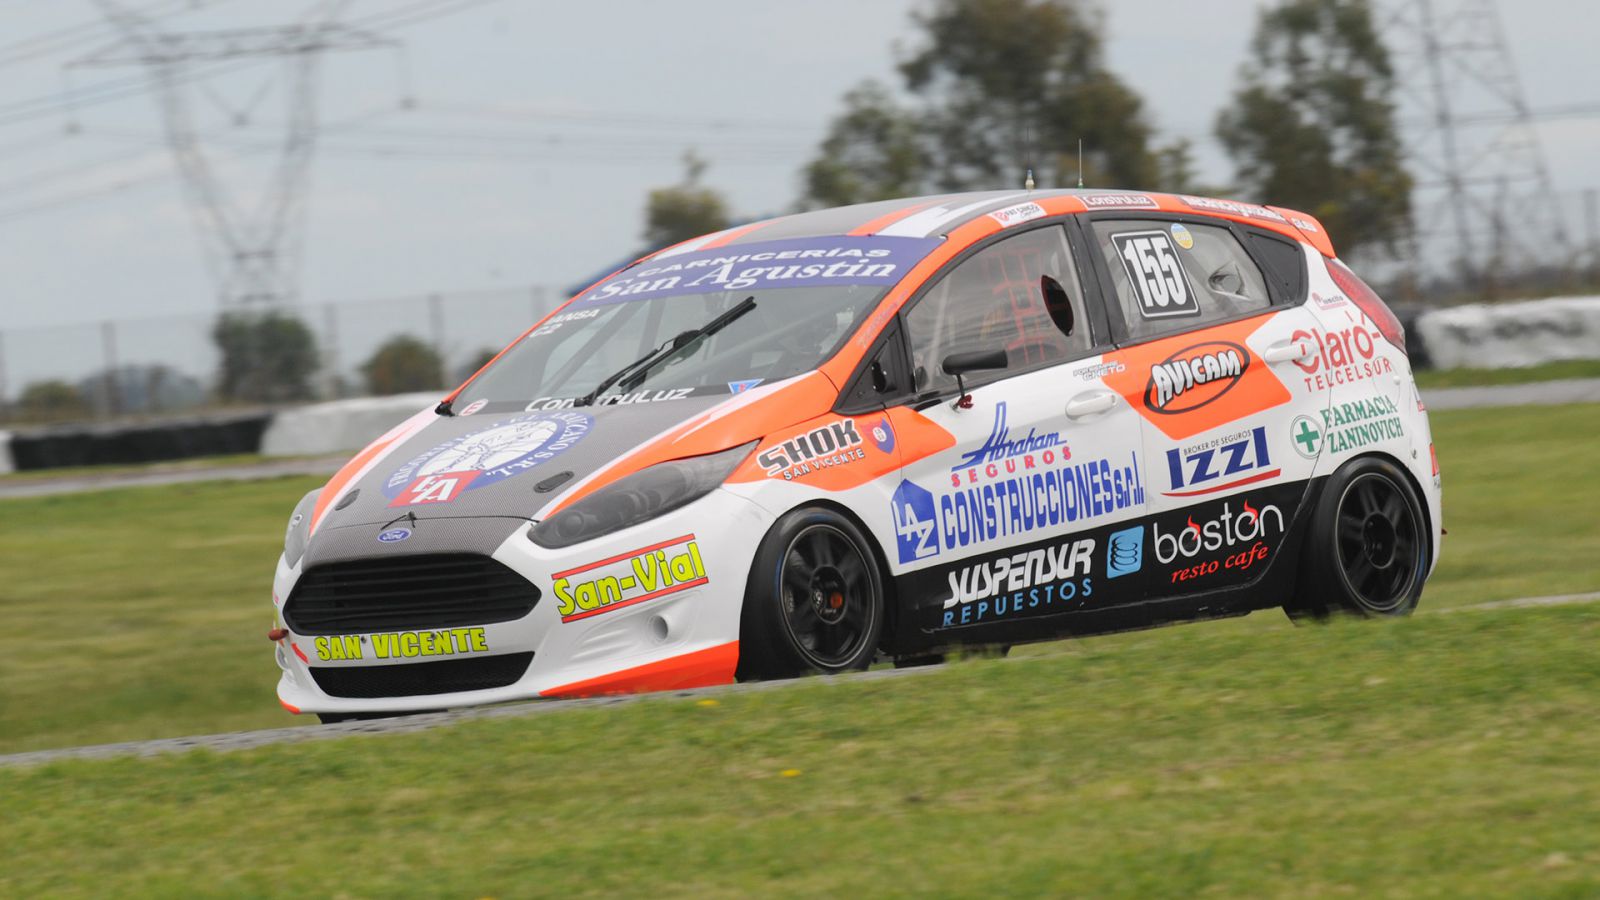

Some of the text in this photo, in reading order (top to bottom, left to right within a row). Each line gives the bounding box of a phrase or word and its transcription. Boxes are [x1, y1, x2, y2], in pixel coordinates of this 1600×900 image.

[636, 247, 892, 279] CARNICERÍAS
[1123, 236, 1187, 307] 155
[586, 274, 677, 302] San
[1291, 325, 1374, 375] Claro
[1151, 349, 1241, 408] AVICAM
[1304, 357, 1393, 393] TELCELSUR
[524, 387, 696, 412] ContruLuz
[1320, 394, 1398, 428] FARMACIA
[757, 419, 862, 477] SHOK
[951, 401, 1068, 472] Abraham
[1184, 429, 1252, 456] BROKER DE SEGUROS
[1327, 416, 1405, 454] ZANINOVICH
[783, 447, 866, 482] SAN VICENTE
[951, 446, 1072, 488] SEGUROS
[1166, 426, 1271, 491] IZZI
[940, 459, 1114, 550] CONSTRUCCIONES
[1154, 499, 1285, 564] boston
[553, 541, 707, 617] San-Vial
[943, 539, 1096, 610] SUSPENSUR
[1171, 541, 1269, 584] resto cafe
[942, 578, 1093, 627] REPUESTOS
[314, 627, 489, 662] SAN VICENTE
